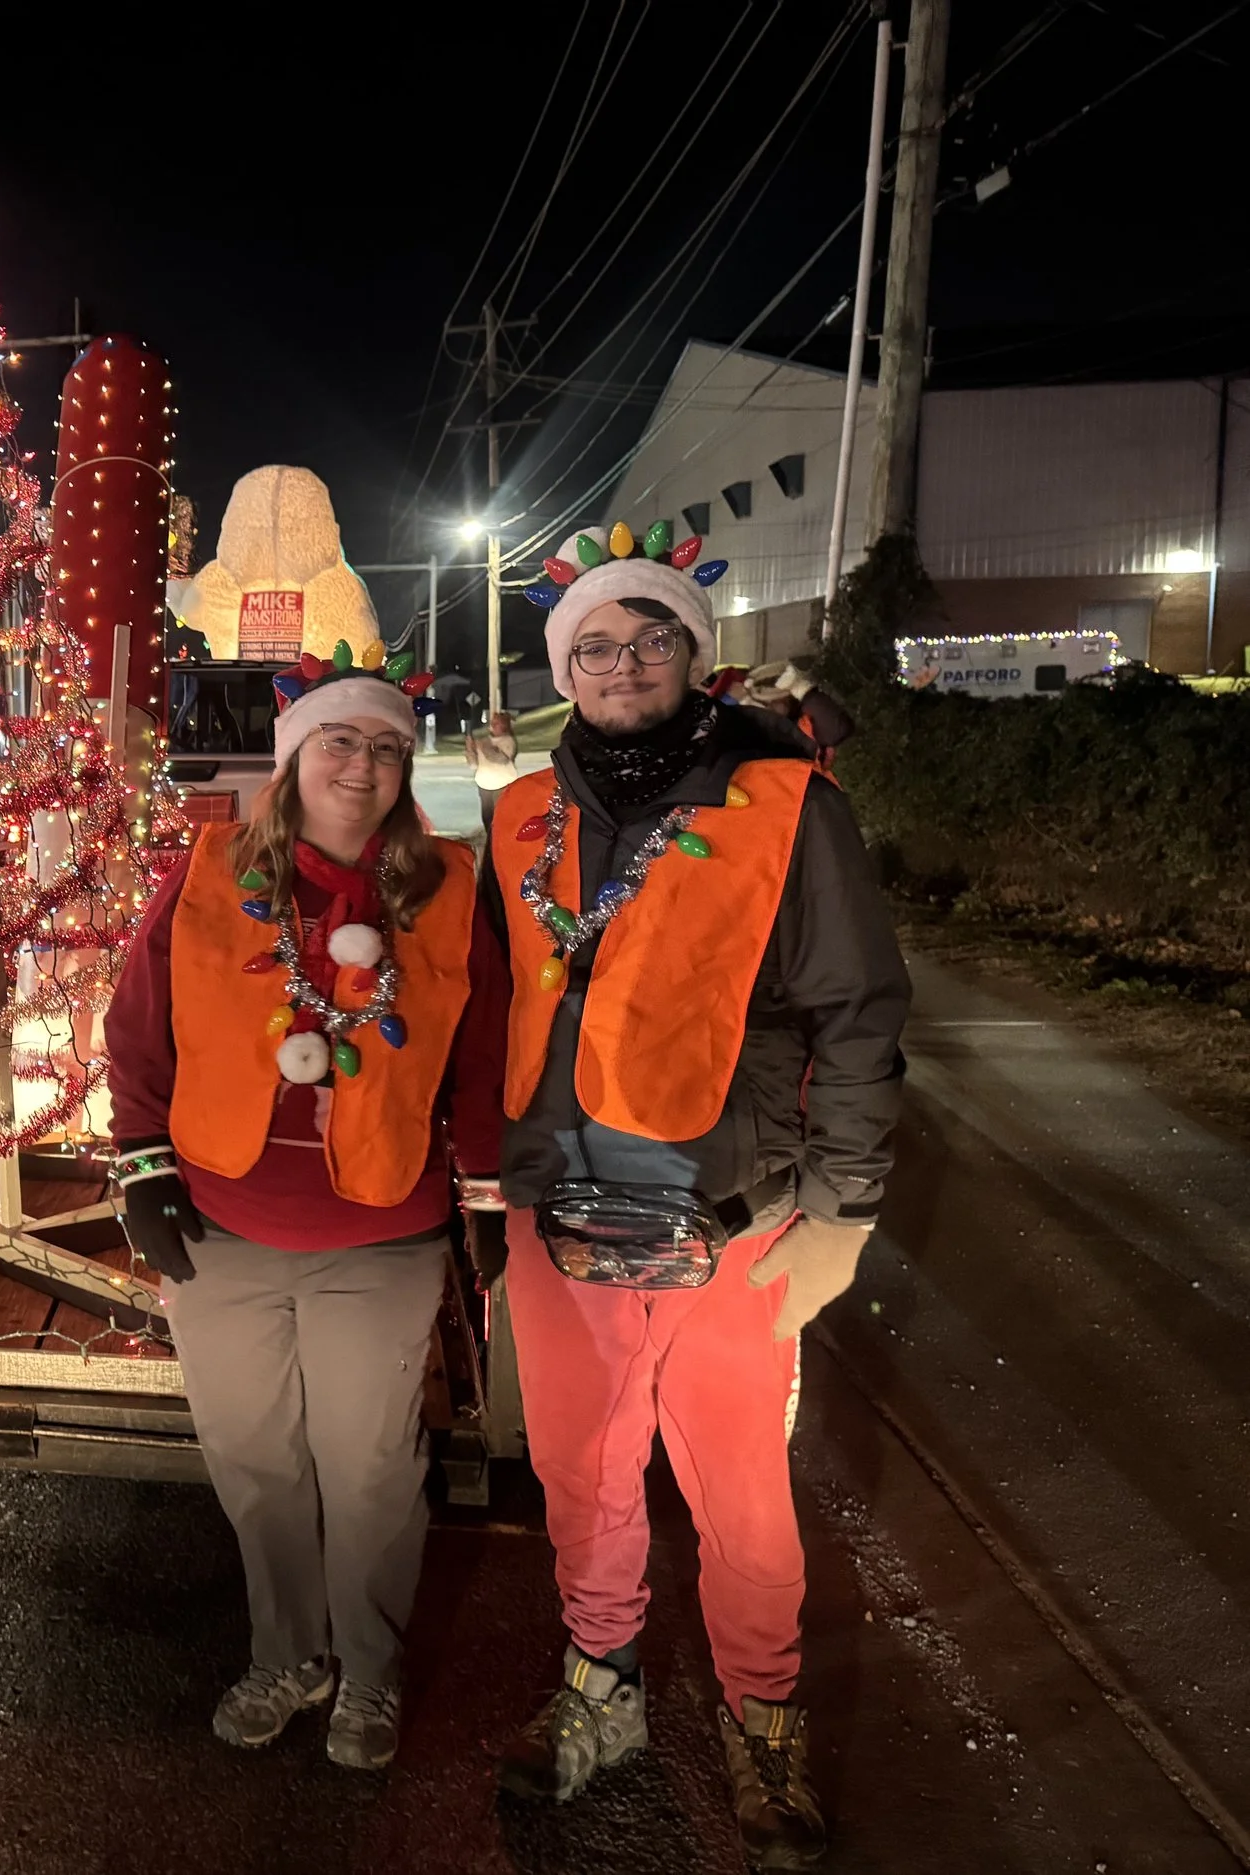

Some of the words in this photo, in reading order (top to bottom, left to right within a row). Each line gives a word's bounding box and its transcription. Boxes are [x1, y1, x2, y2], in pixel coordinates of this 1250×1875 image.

[248, 593, 297, 609] MIKE
[241, 609, 301, 626] ARMSTRONG
[262, 642, 274, 651] FOR
[943, 668, 1021, 682] PAFFORD
